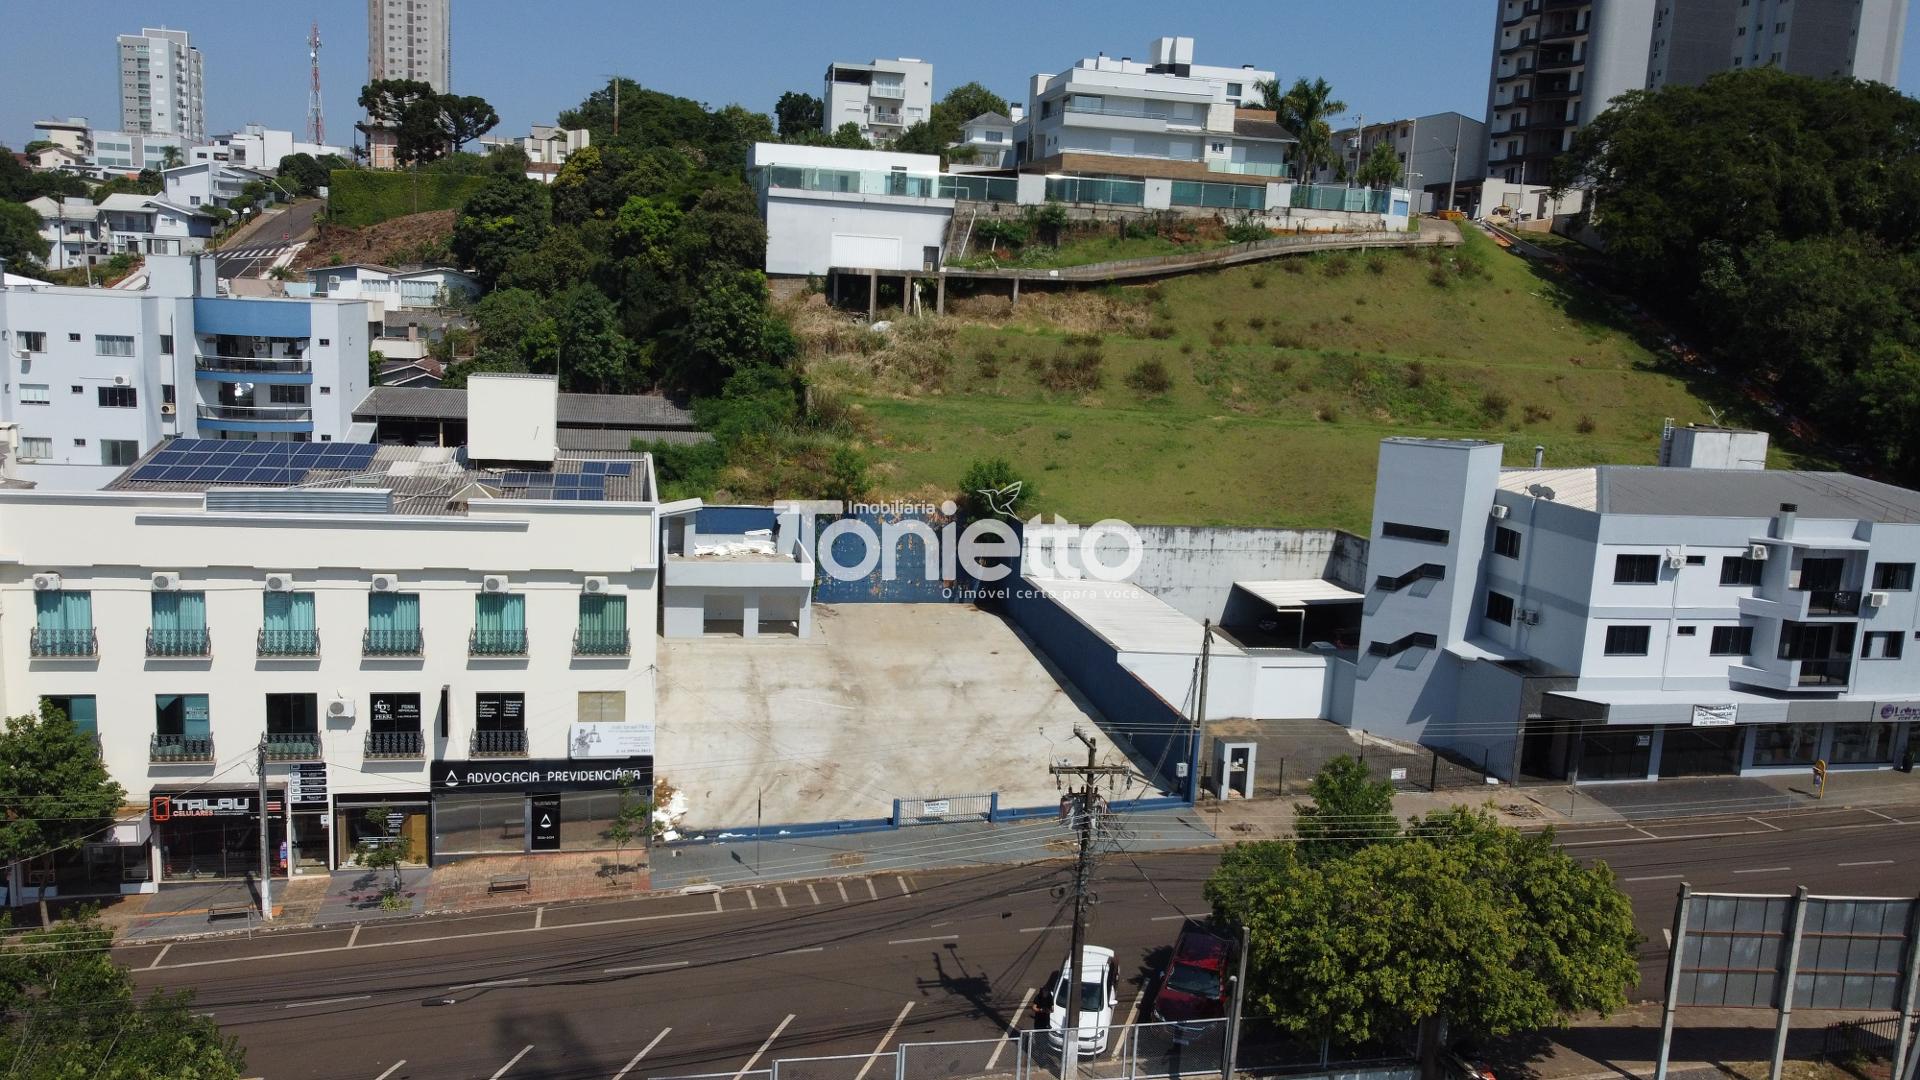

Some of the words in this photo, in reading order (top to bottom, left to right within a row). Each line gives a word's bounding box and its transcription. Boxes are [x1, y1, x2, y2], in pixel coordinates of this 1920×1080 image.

[467, 772, 540, 784] ADVOCACIA
[172, 798, 250, 811] TALAU
[172, 809, 214, 817] CELULARES
